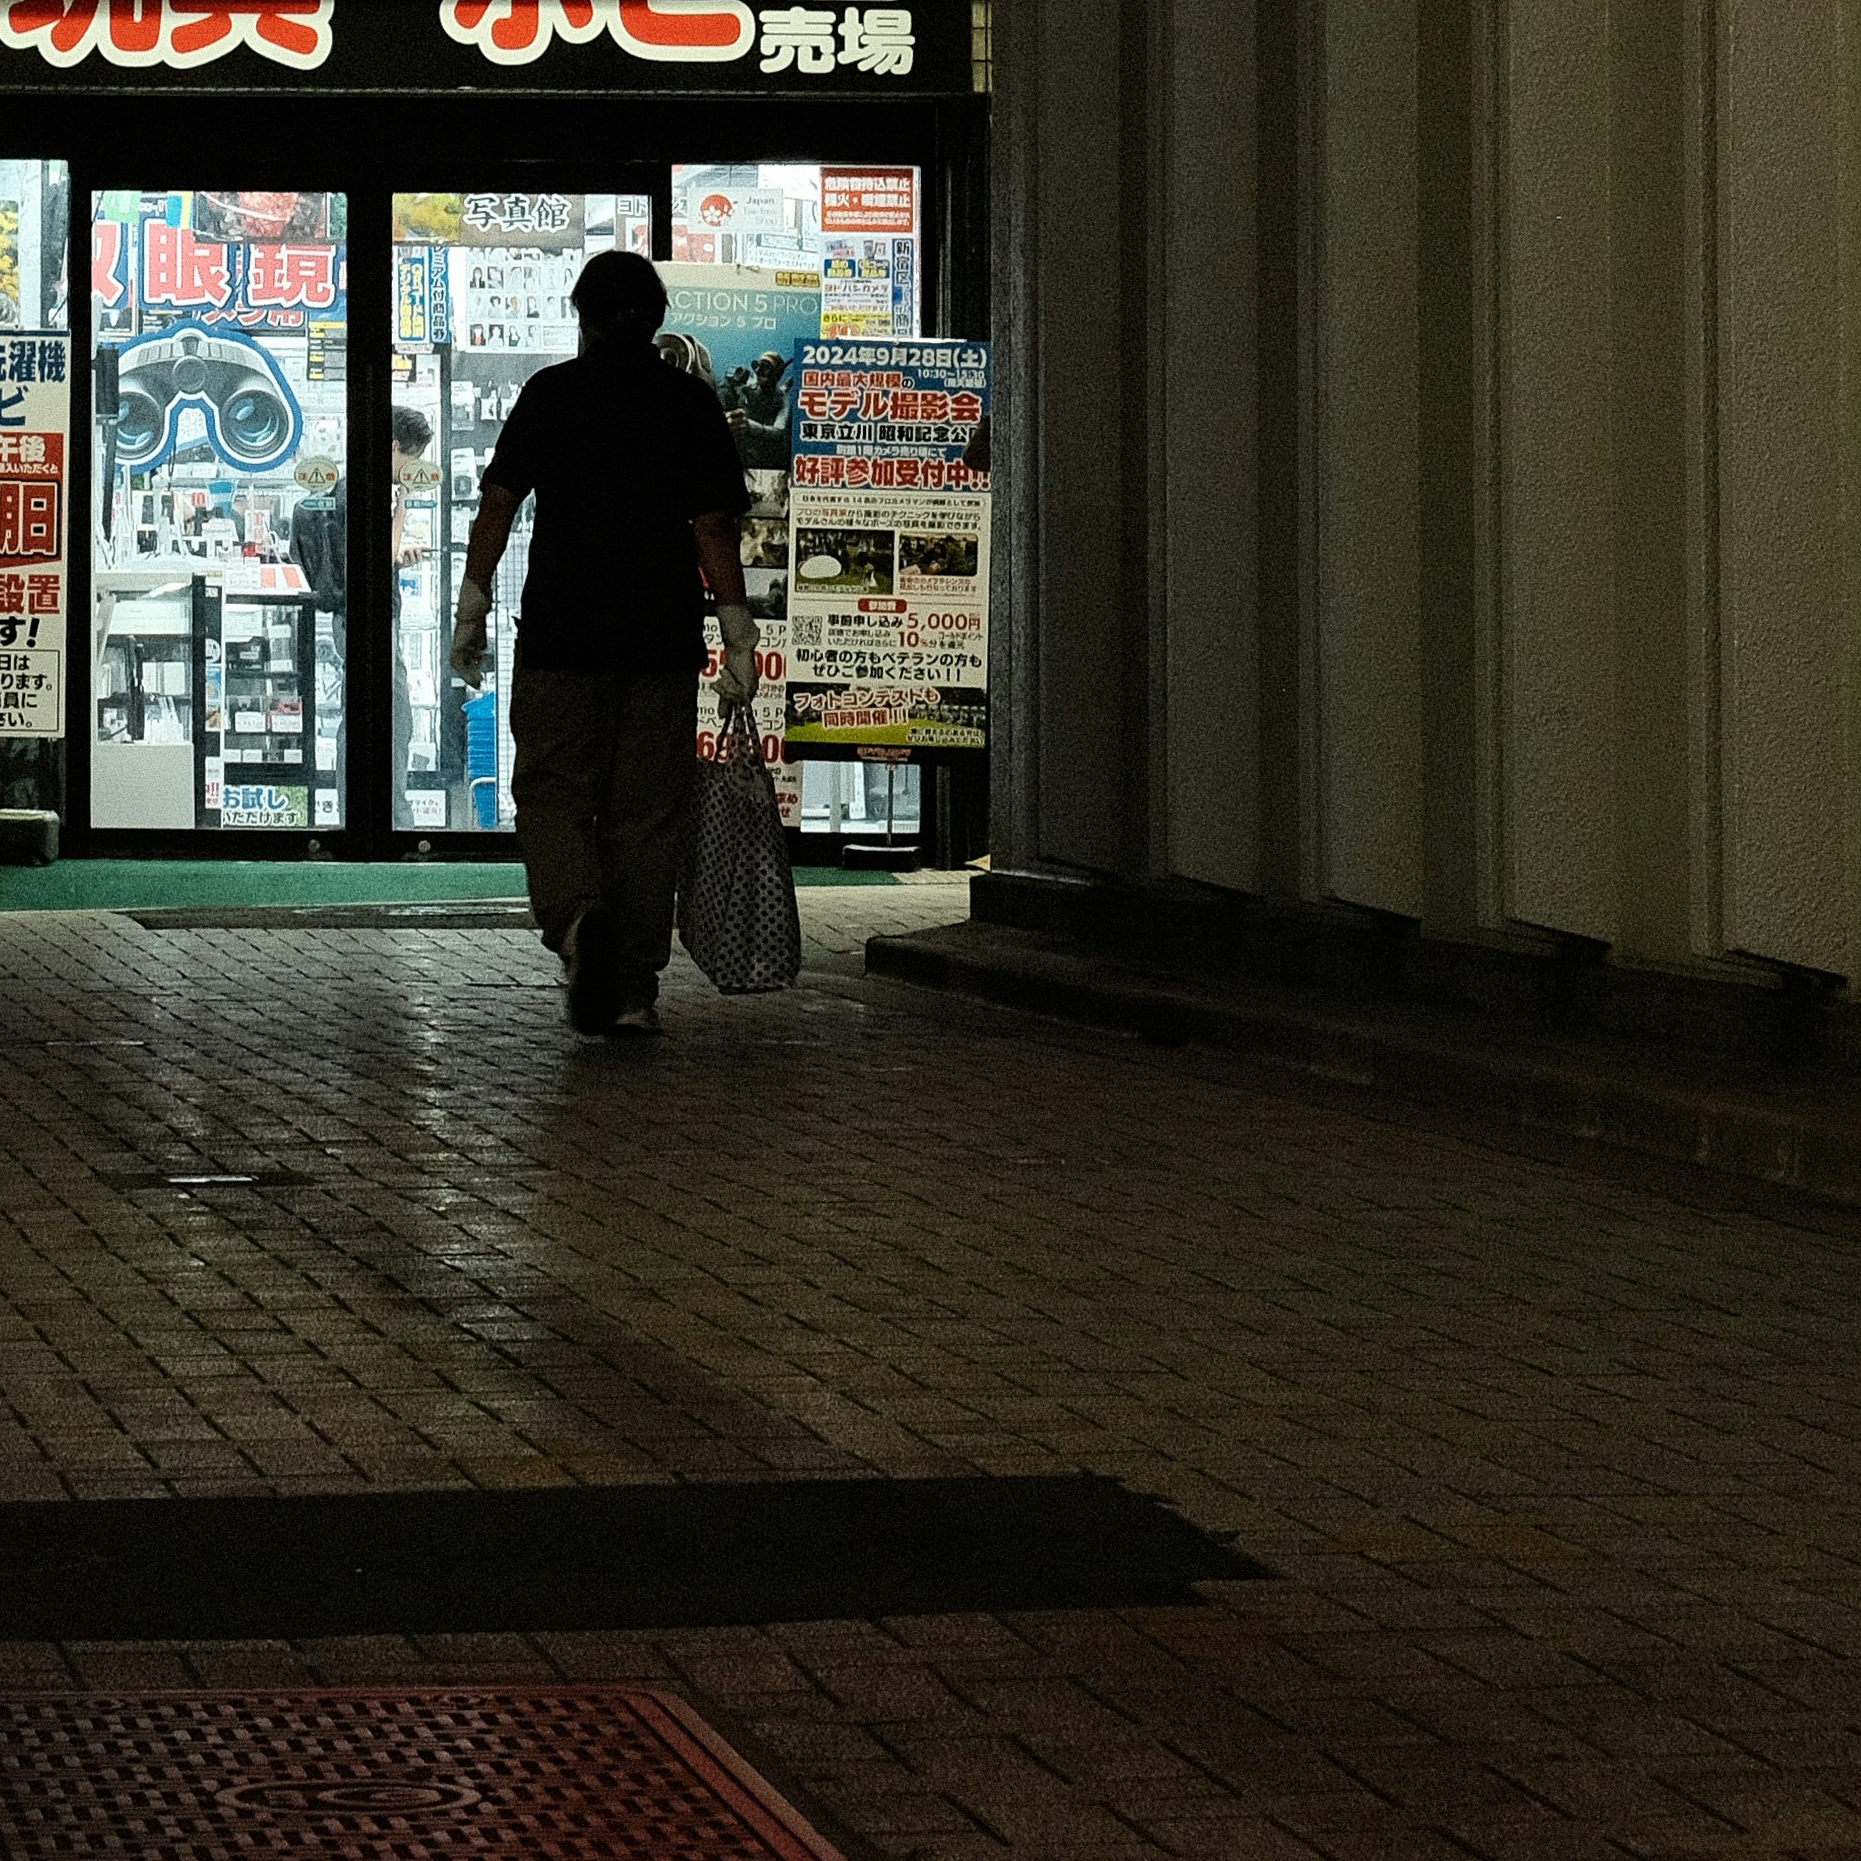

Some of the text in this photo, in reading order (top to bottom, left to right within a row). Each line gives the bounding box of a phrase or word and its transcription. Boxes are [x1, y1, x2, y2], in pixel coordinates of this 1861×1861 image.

[757, 7, 916, 76] 売場
[463, 194, 571, 233] 写真館
[754, 294, 767, 313] 5
[773, 296, 818, 315] PRO
[801, 345, 987, 368] 2024年9月28日(土)
[802, 370, 914, 389] 国内最大規模の
[798, 388, 981, 423] モデル撮影会
[800, 422, 874, 441] 東京立川
[906, 613, 981, 631] 5,000円
[796, 648, 983, 667] 初心者の方もベテランの方も
[793, 687, 941, 709] フォトコンテストも
